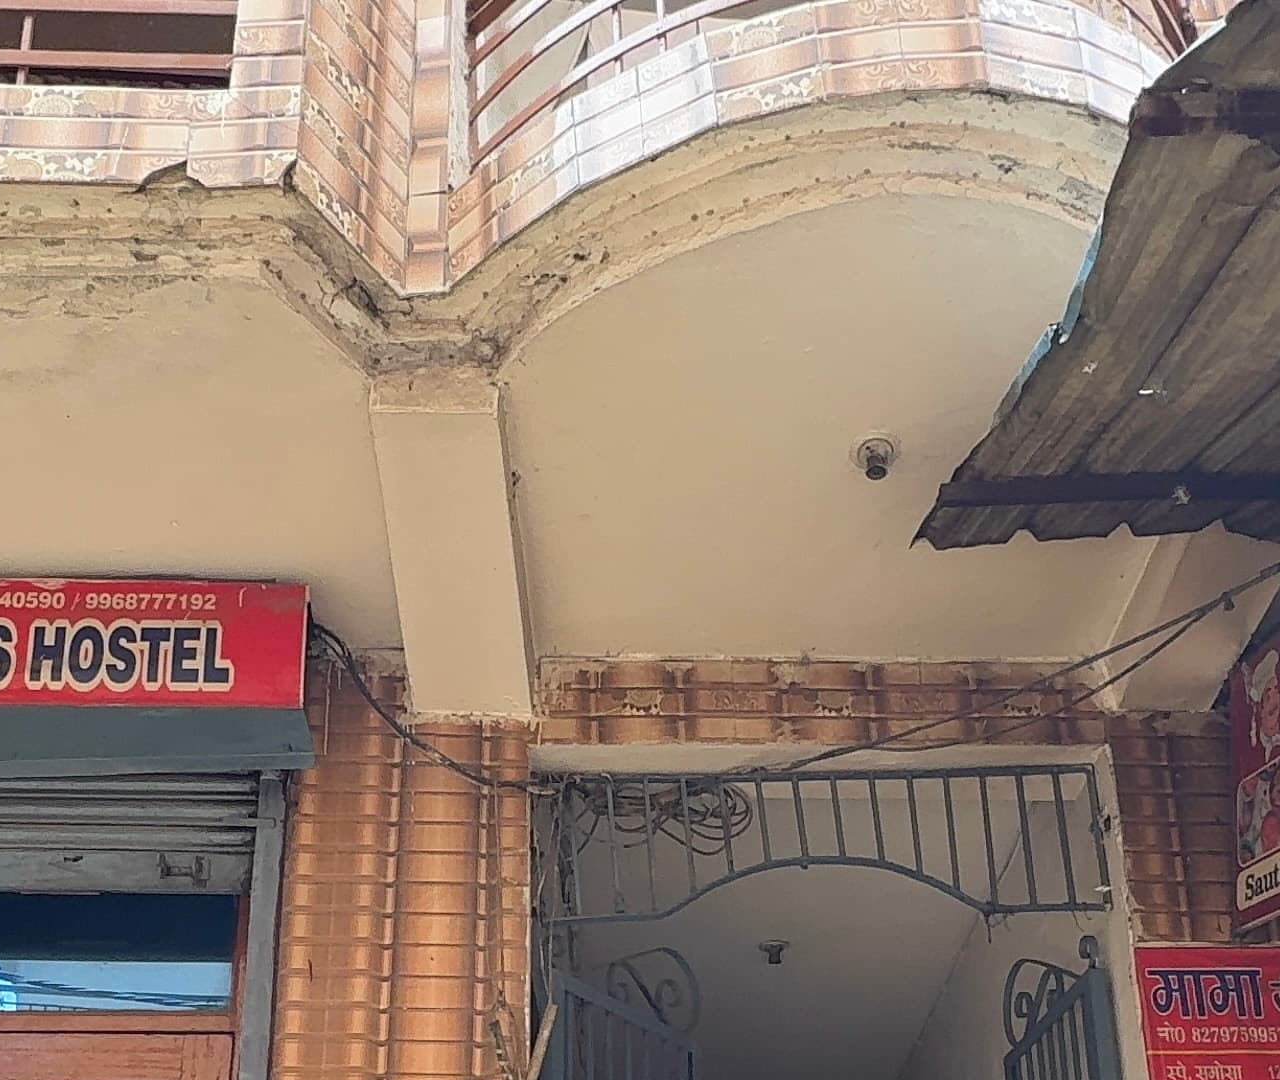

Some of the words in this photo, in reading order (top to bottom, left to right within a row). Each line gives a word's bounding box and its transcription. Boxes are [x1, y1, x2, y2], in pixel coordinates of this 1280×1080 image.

[85, 593, 217, 611] 9968777192
[26, 620, 232, 689] HOSTEL
[1145, 967, 1264, 1019] मामा
[1195, 1061, 1242, 1080] समोसा
